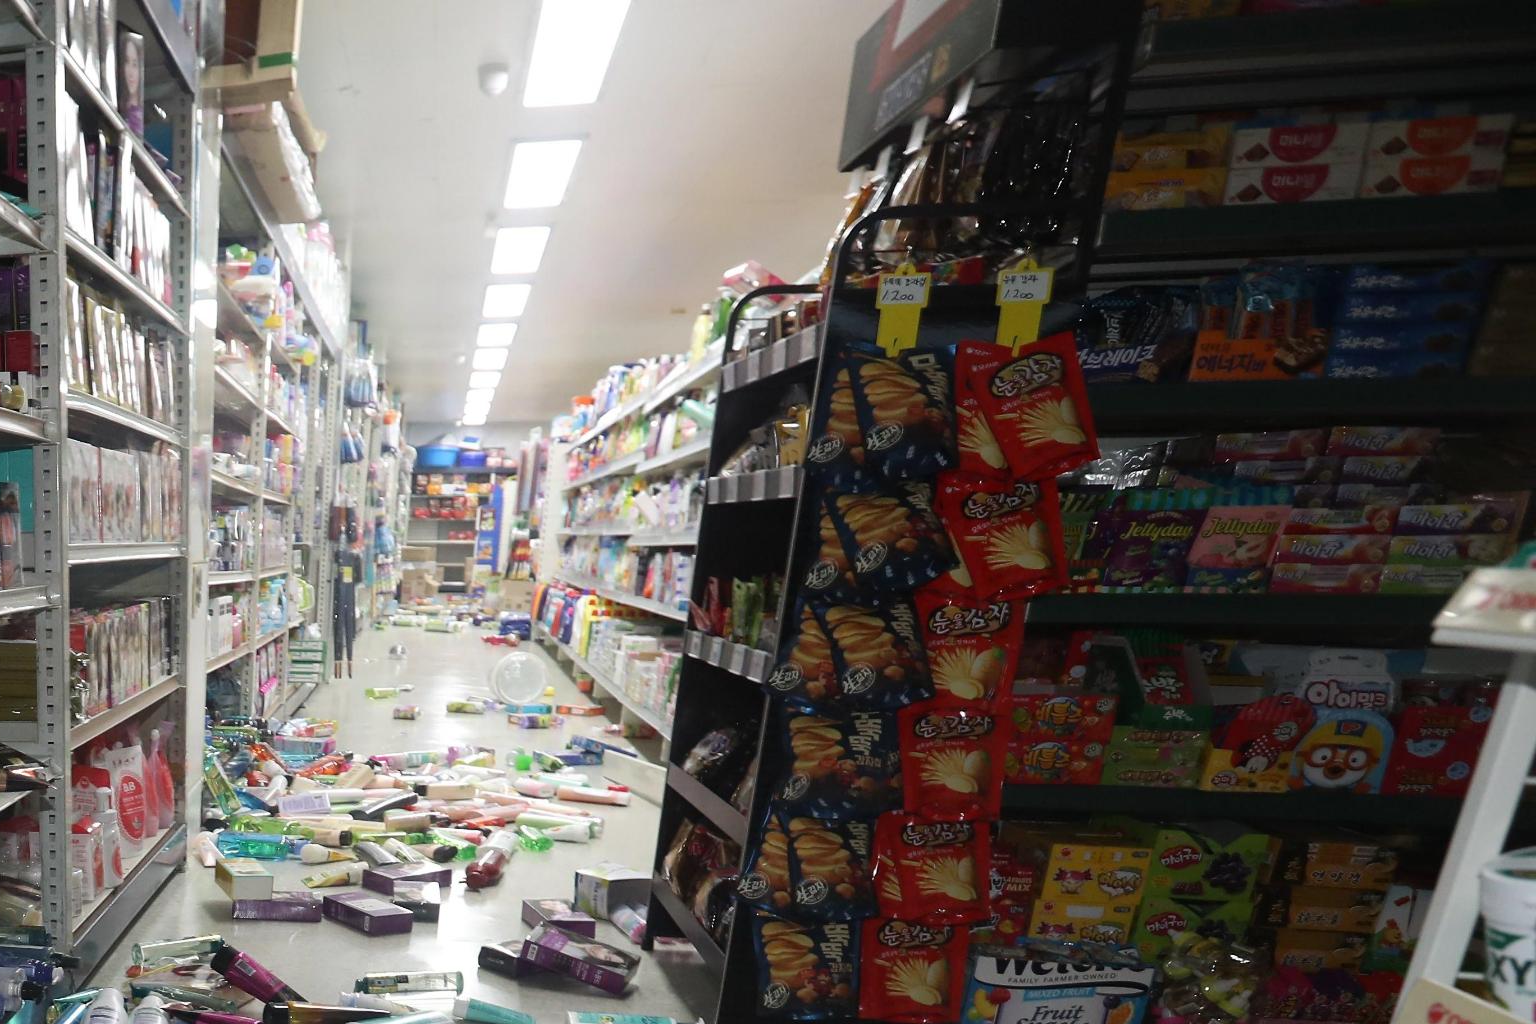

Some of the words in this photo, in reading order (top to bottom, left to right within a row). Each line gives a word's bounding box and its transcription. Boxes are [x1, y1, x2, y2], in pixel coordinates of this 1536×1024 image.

[992, 353, 1062, 398] 눈을감자
[965, 483, 1038, 519] 눈을감자
[1121, 520, 1194, 540] Jellyday
[931, 603, 1010, 634] 눈을감자
[1159, 846, 1203, 869] 마이구미
[1008, 976, 1040, 984] FAMILY
[1043, 975, 1079, 983] FARMER
[1083, 973, 1116, 981] OWNED
[1028, 989, 1059, 998] MIXED
[1063, 988, 1090, 998] FRUIT
[1032, 1005, 1085, 1021] Fruit
